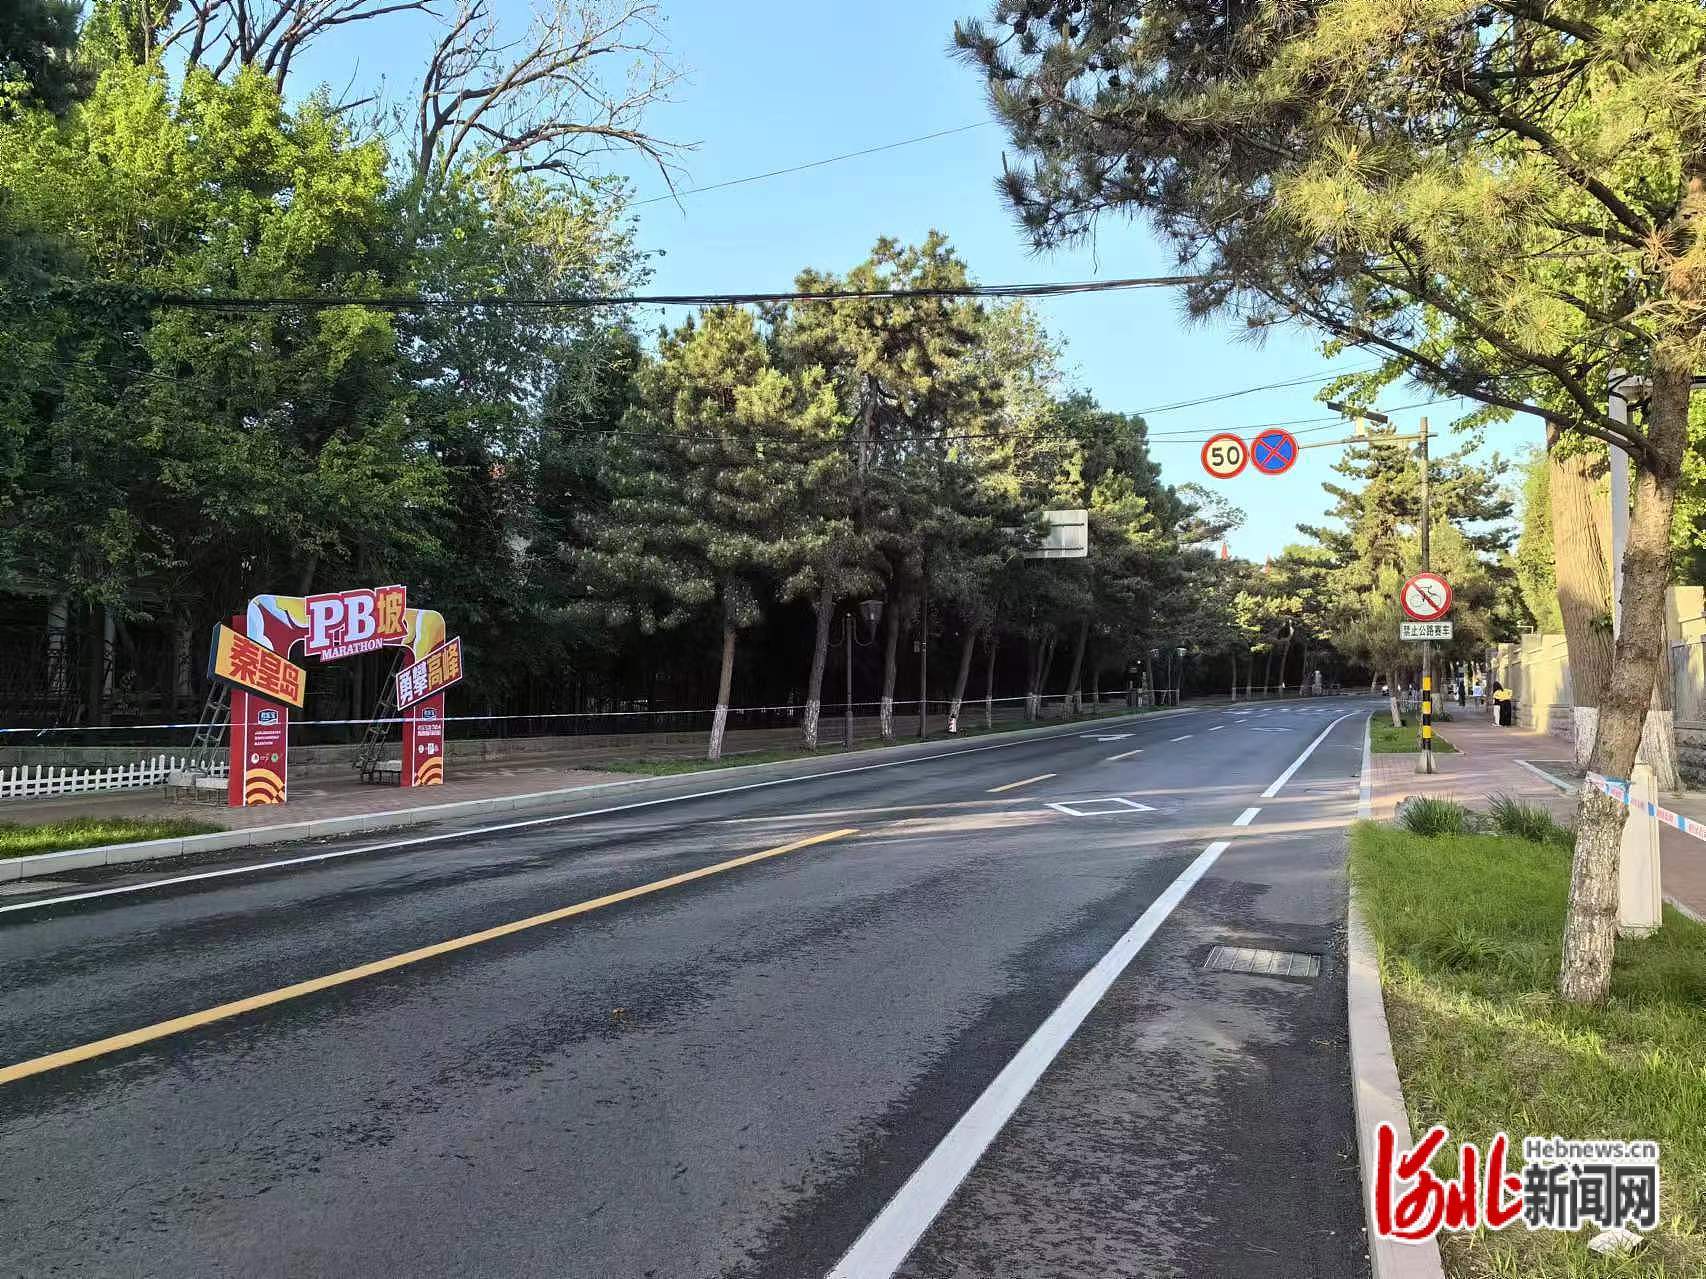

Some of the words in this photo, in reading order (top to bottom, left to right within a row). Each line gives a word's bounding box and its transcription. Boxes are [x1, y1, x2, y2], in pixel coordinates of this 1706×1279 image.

[1211, 445, 1240, 467] 50
[1402, 624, 1450, 637] 禁止公路赛车
[320, 638, 383, 661] MARATHON
[229, 634, 300, 702] 秦皇岛
[398, 642, 460, 707] 勇攀高峰
